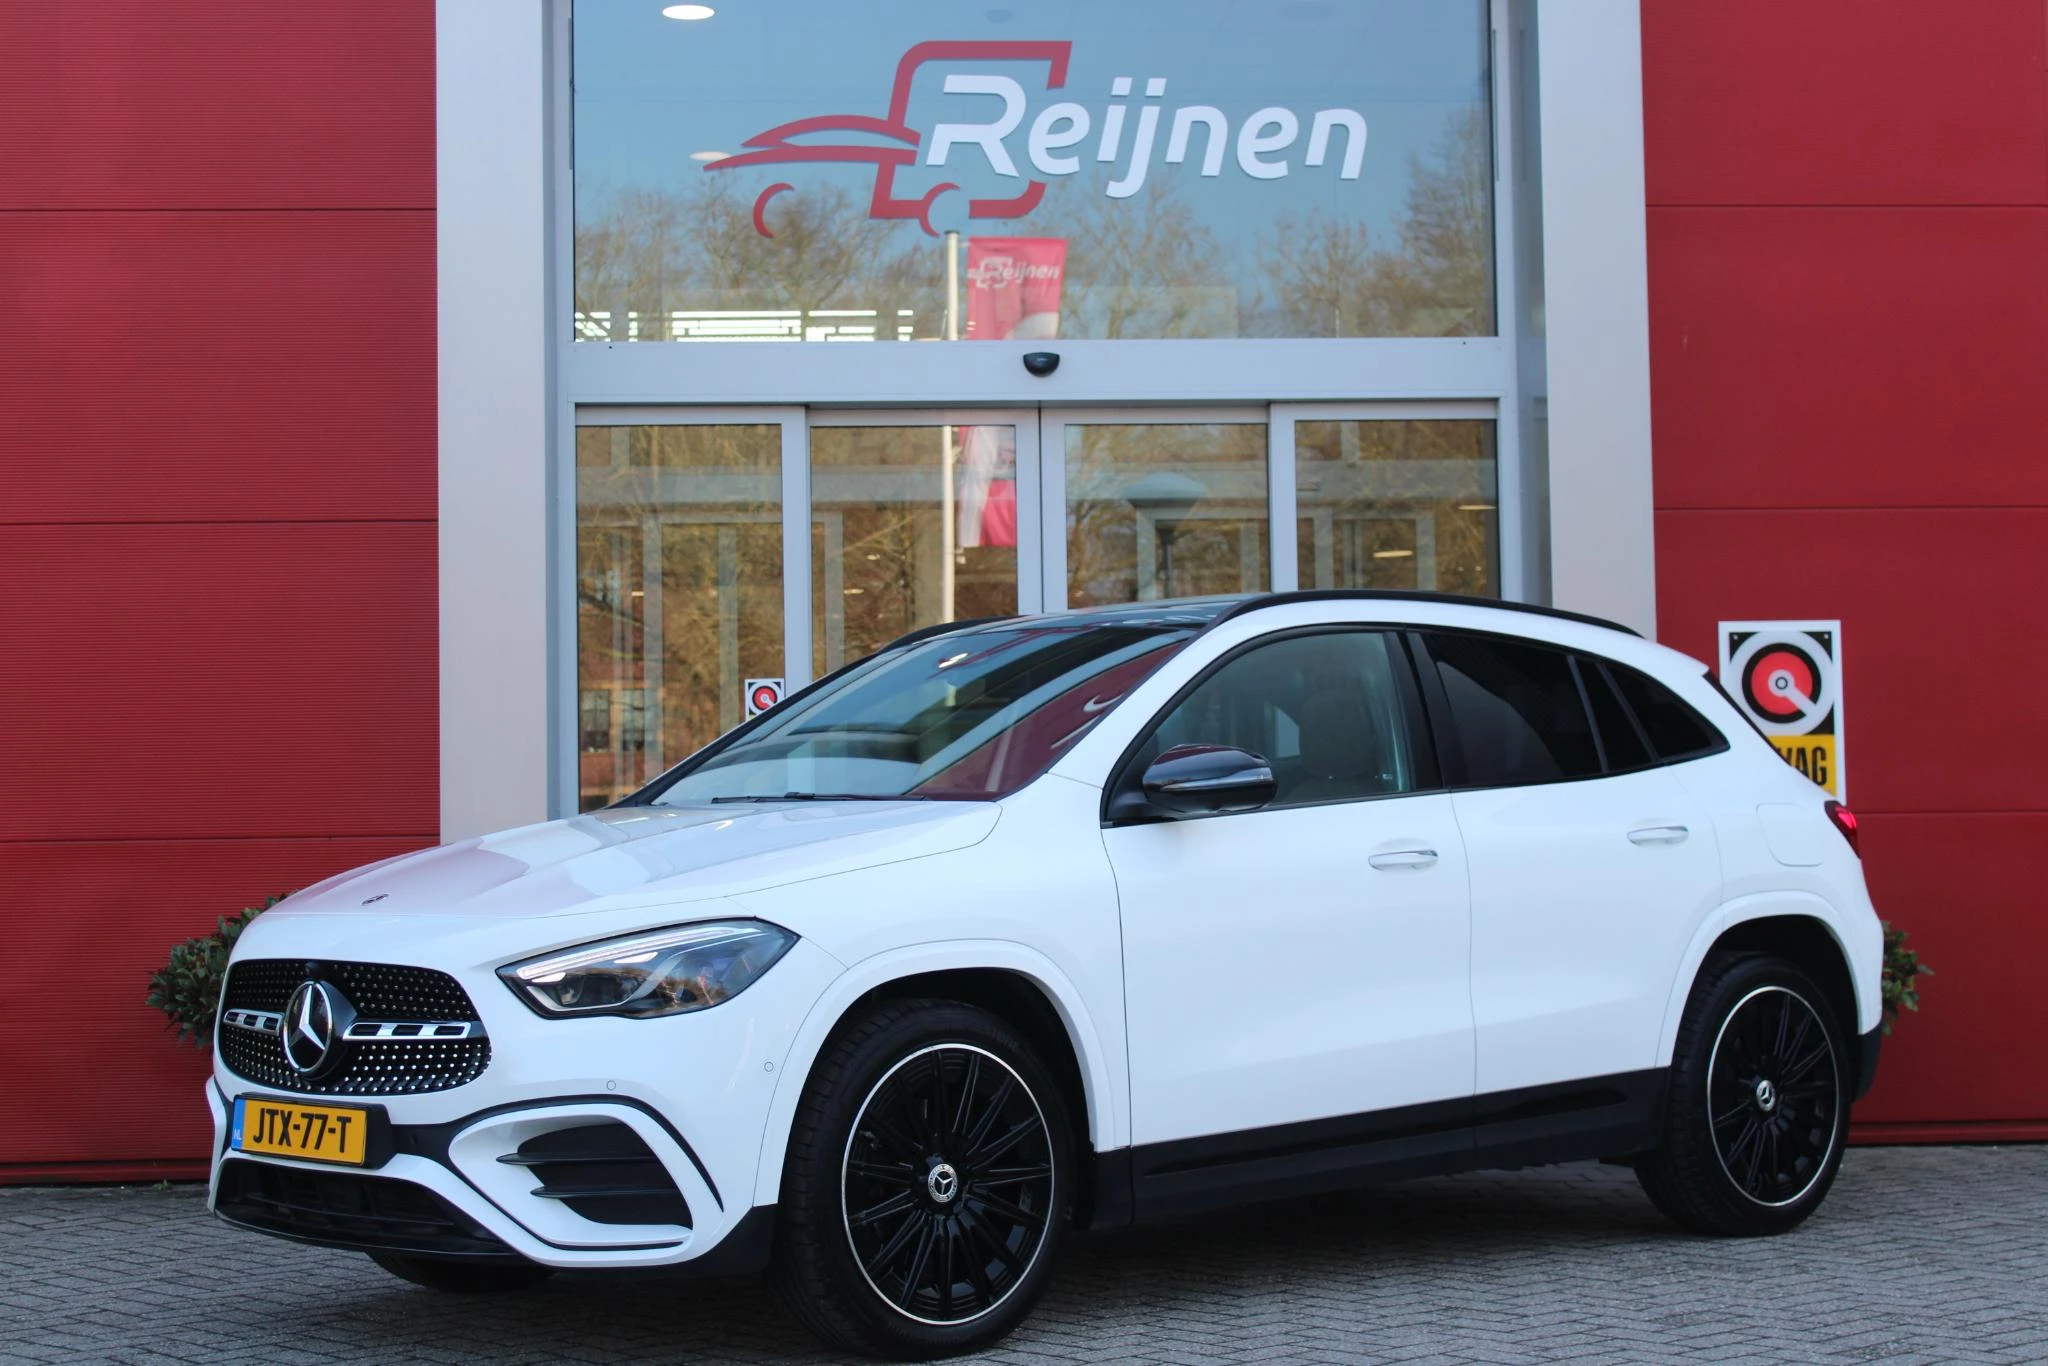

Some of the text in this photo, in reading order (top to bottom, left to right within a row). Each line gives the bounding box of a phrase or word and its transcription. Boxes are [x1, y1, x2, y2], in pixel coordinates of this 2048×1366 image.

[926, 74, 1368, 199] Reijnen
[233, 1128, 243, 1140] NL
[252, 1107, 352, 1154] JTX-77-T
